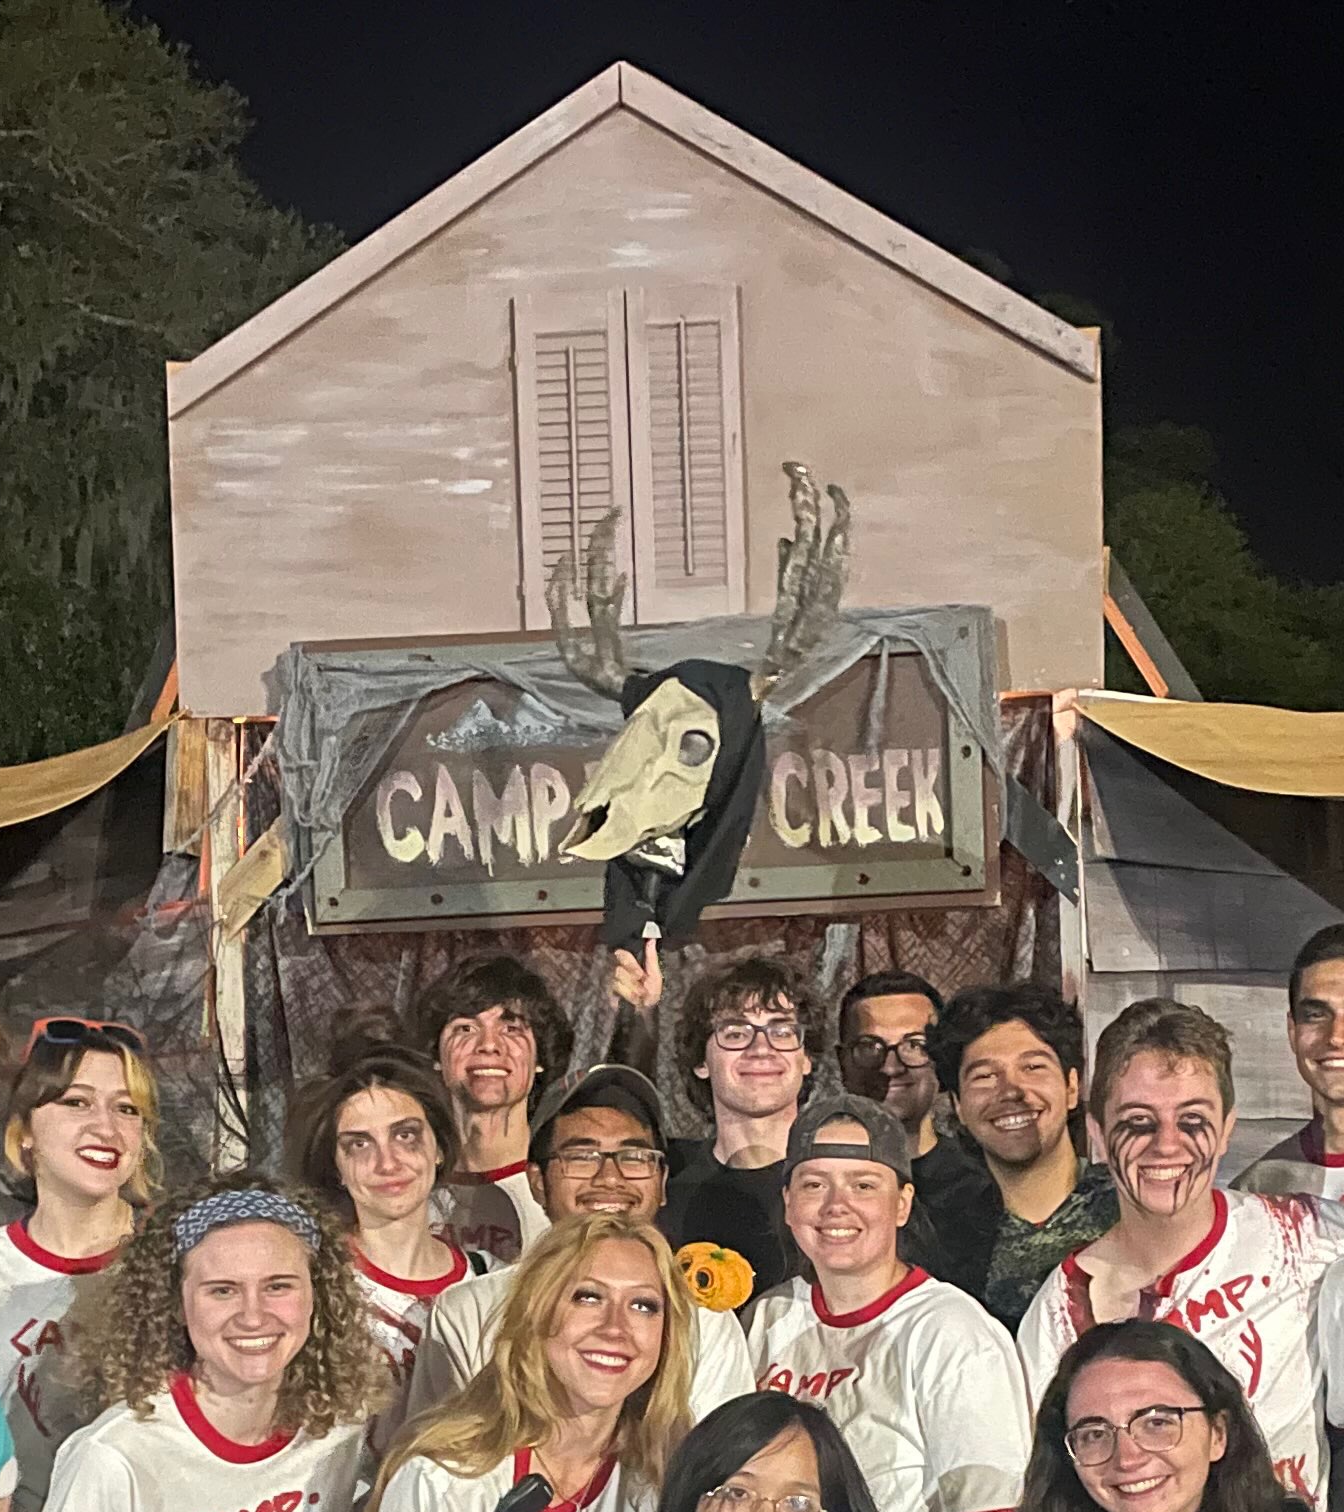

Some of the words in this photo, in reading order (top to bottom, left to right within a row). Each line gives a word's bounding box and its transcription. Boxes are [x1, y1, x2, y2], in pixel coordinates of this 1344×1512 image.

[376, 762, 571, 877] CAMP
[769, 747, 946, 849] CREEK
[757, 1363, 856, 1399] CAMP
